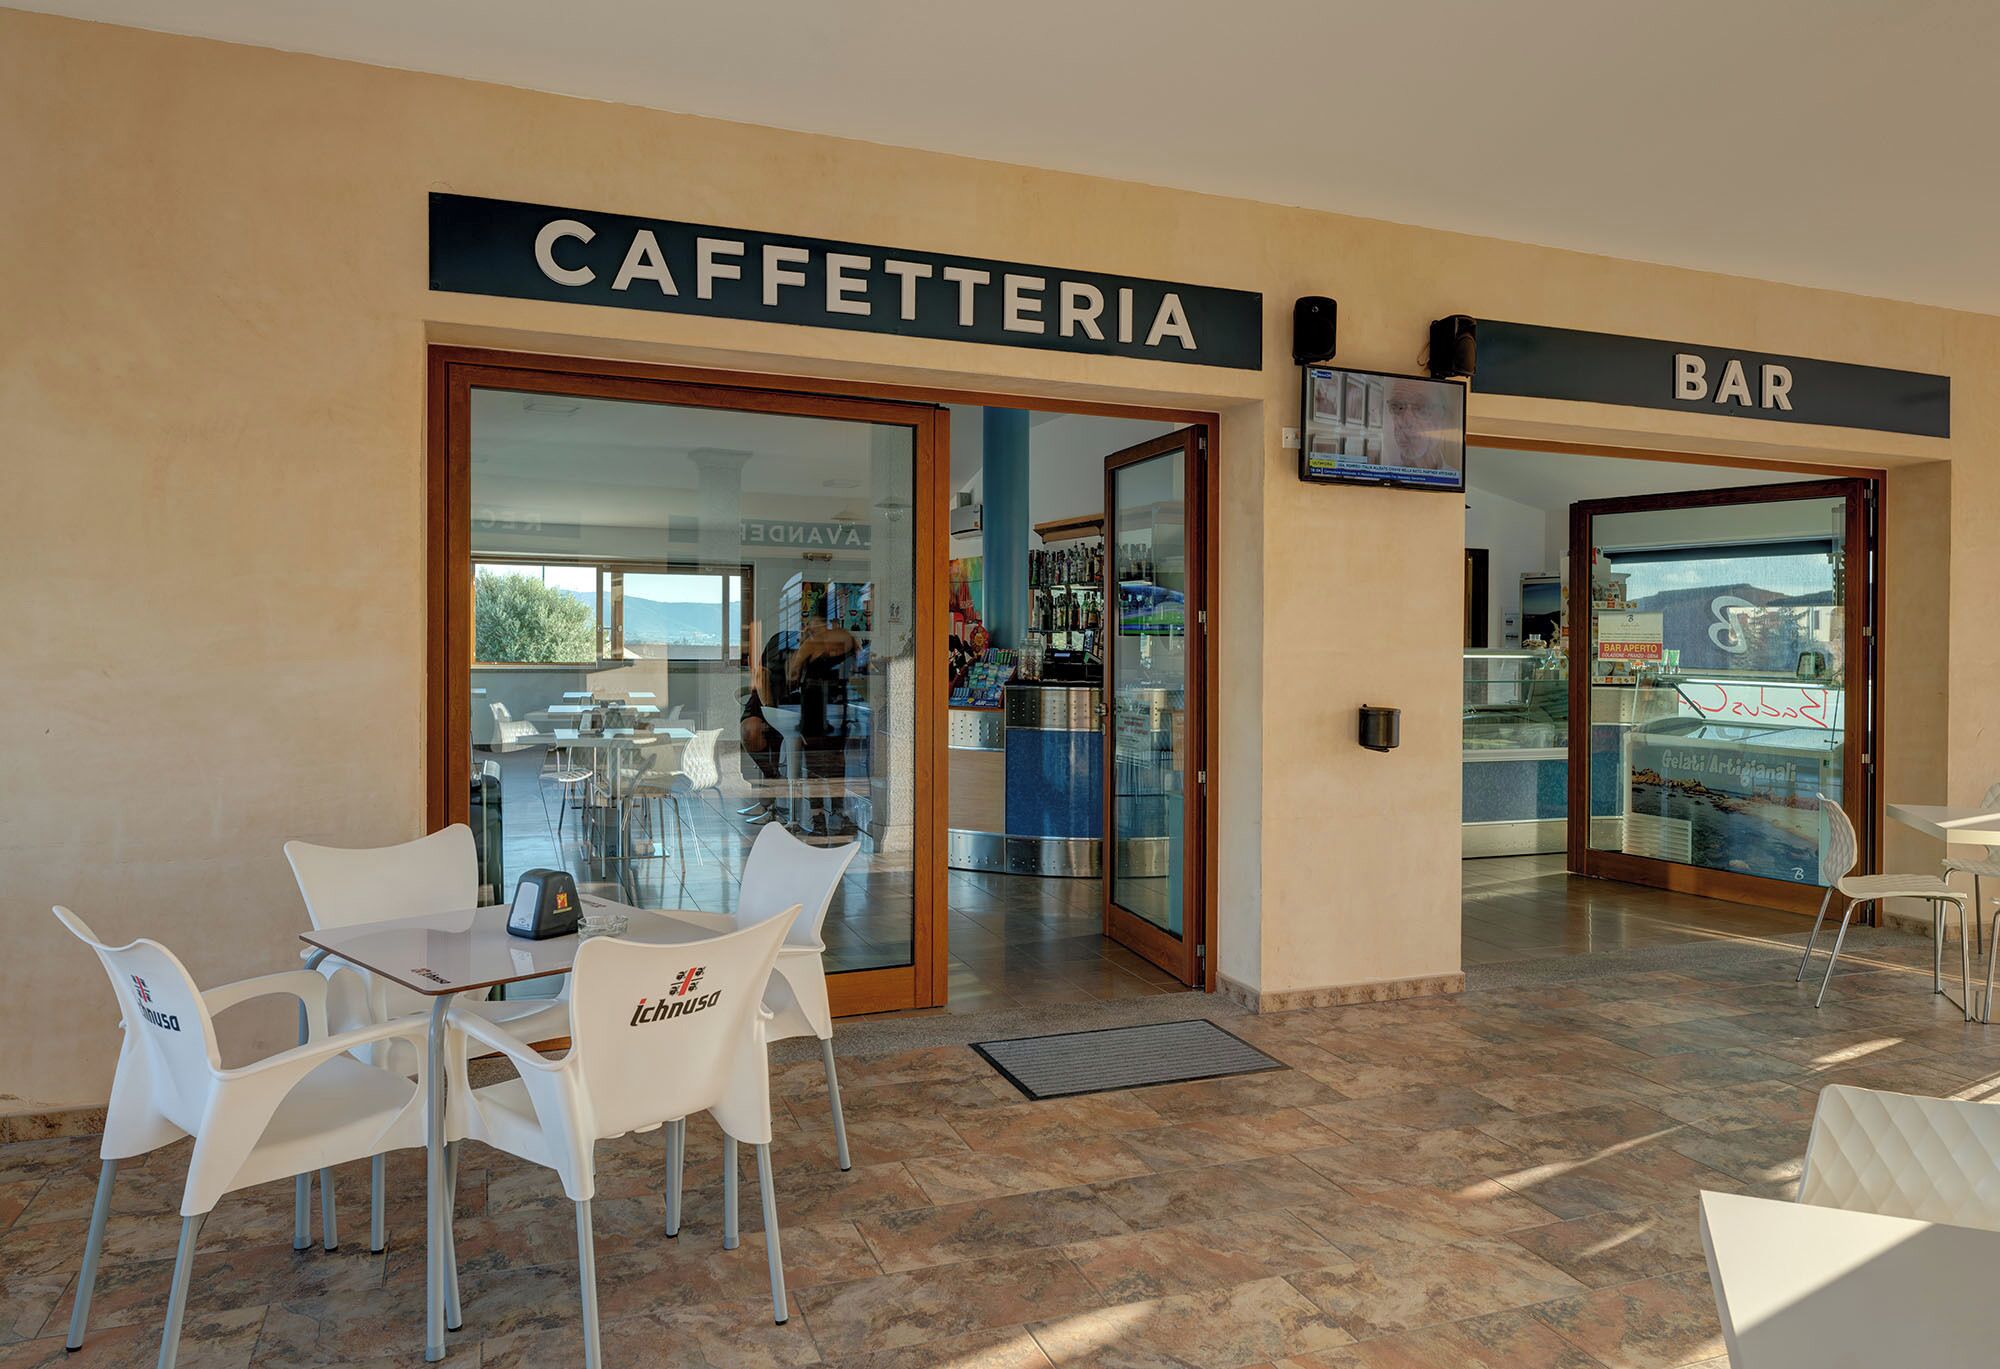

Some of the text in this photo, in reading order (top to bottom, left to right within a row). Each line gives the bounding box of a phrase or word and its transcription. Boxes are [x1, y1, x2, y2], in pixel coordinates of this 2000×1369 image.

[534, 218, 1199, 351] CAFFETTERIA
[1673, 353, 1793, 411] BAR
[1604, 644, 1658, 653] BAR APERTO
[1661, 748, 1797, 788] Gelati Artigianali
[136, 997, 182, 1032] nusa
[630, 990, 722, 1027] ichnusa
